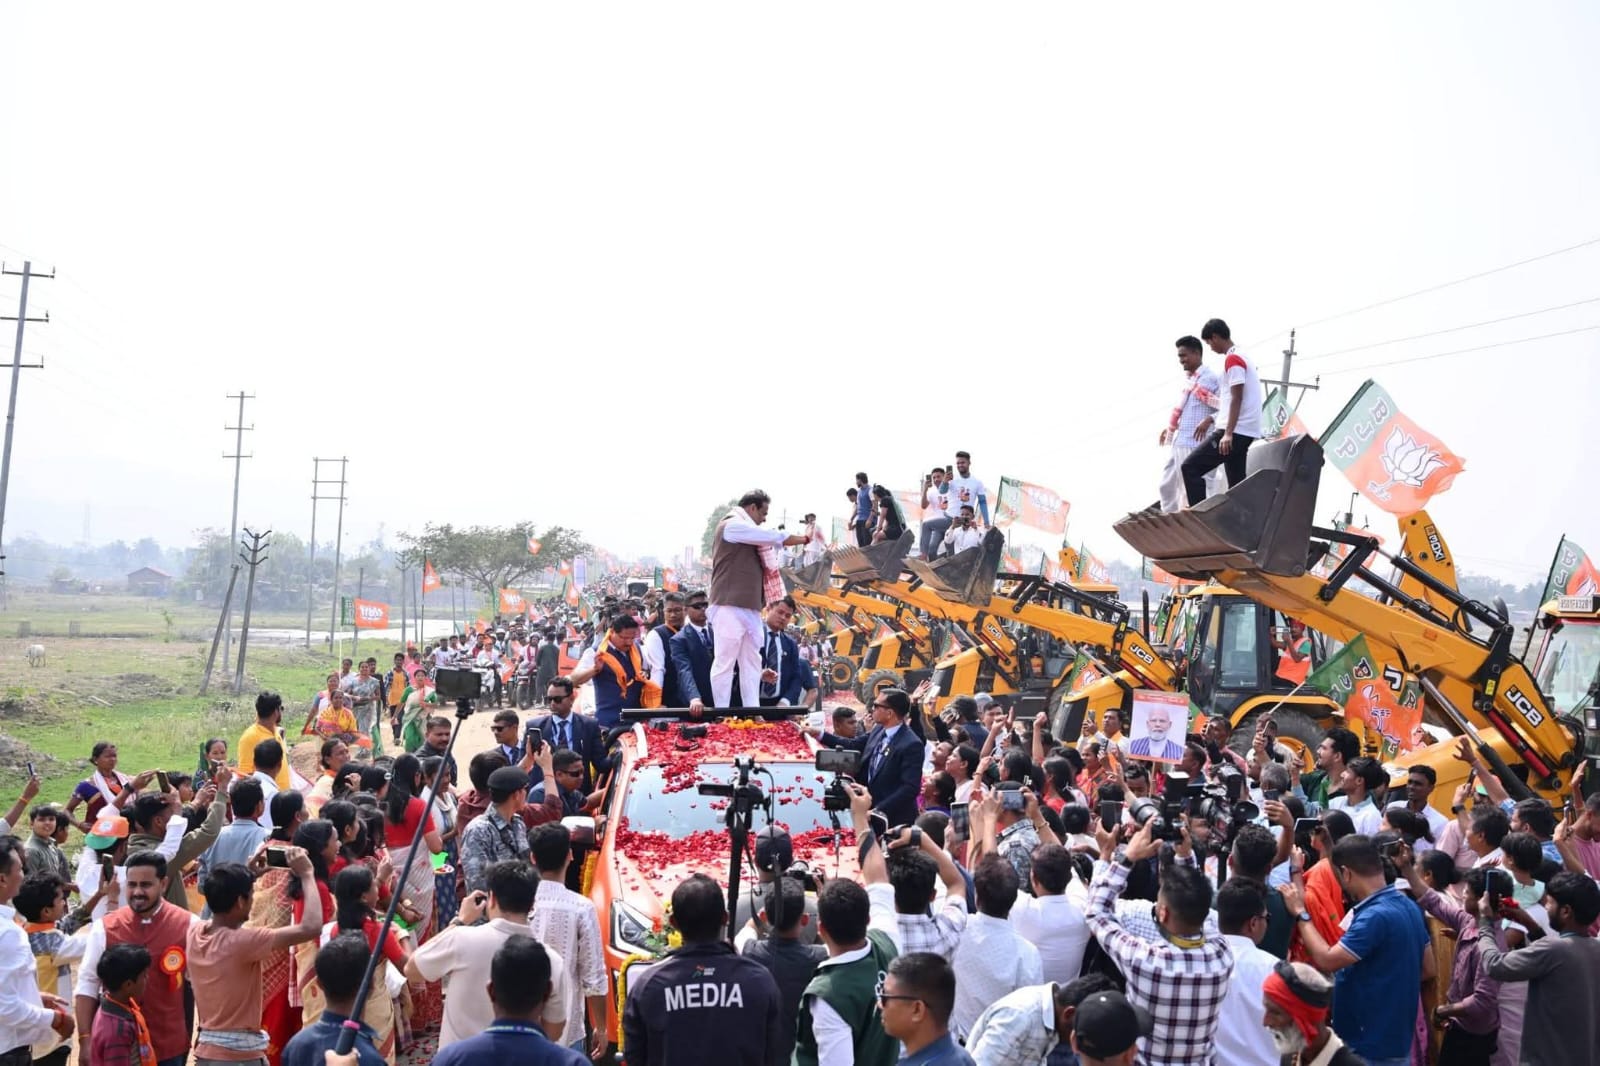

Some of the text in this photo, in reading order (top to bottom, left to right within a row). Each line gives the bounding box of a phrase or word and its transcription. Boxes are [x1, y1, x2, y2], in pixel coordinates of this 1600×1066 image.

[1334, 397, 1390, 459] BJP
[986, 624, 1002, 639] JCB
[1130, 643, 1154, 664] JCB
[1506, 690, 1542, 726] JCB
[664, 982, 744, 1012] MEDIA
